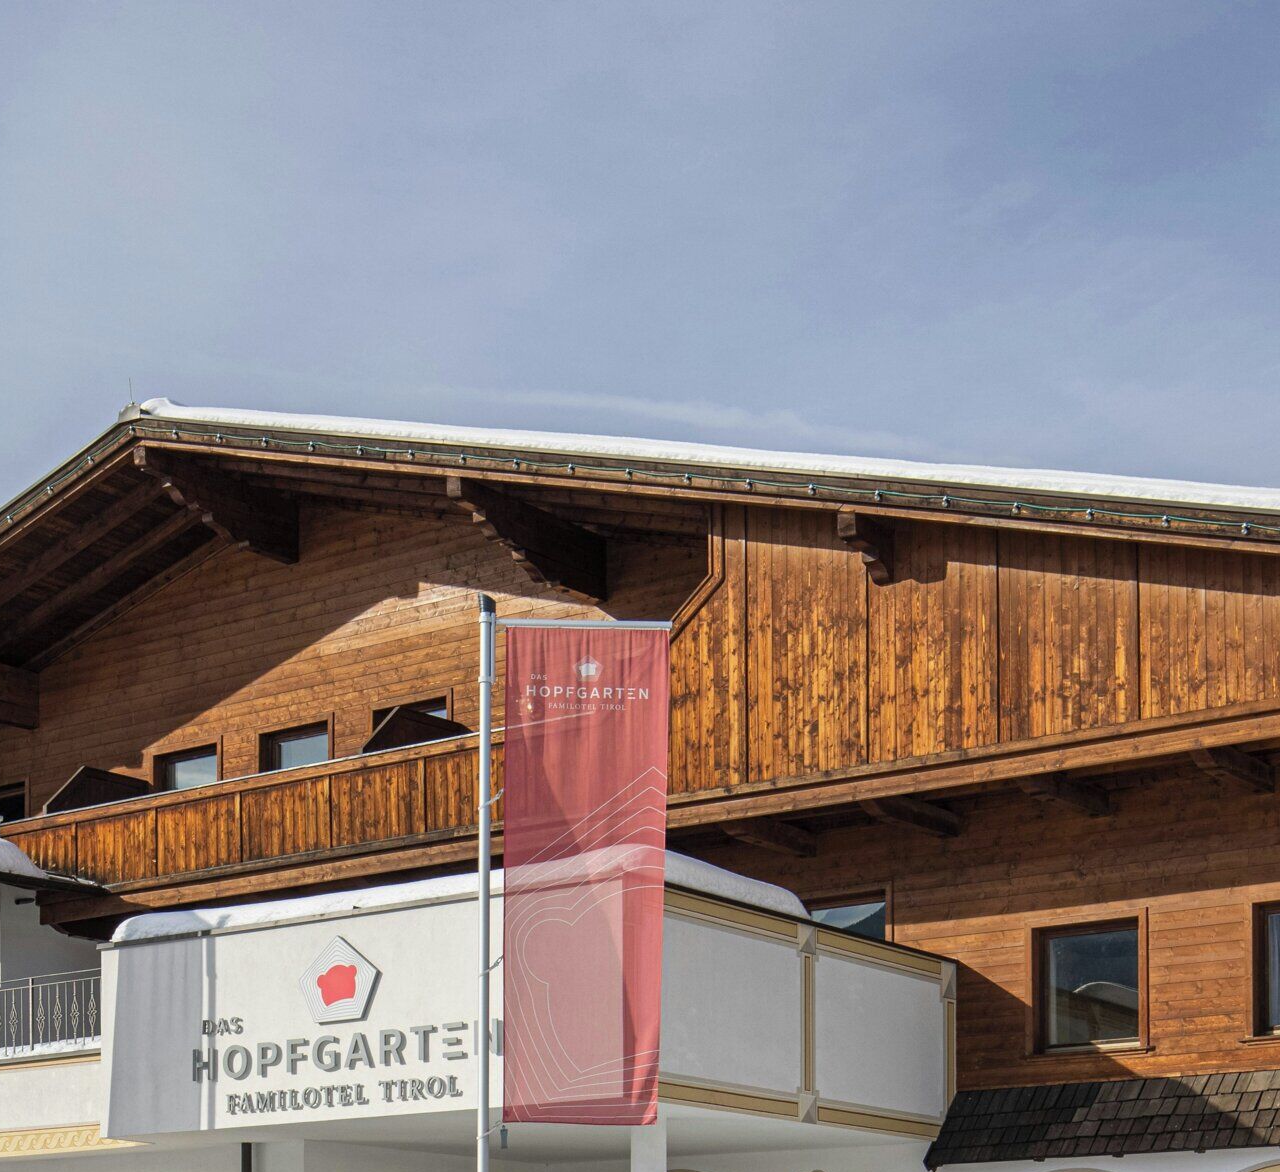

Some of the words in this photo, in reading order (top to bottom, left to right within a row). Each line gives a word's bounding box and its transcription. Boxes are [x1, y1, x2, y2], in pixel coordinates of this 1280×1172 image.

[530, 673, 548, 681] DAS
[526, 685, 649, 699] HOPFGARTEN
[548, 703, 597, 711] FAMILOTEL
[600, 703, 627, 711] TIROL
[202, 1016, 244, 1035] DAS
[192, 1017, 503, 1082] HOPFGARTEN
[226, 1083, 369, 1114] FAMILOTEL
[378, 1075, 464, 1102] TIROL
